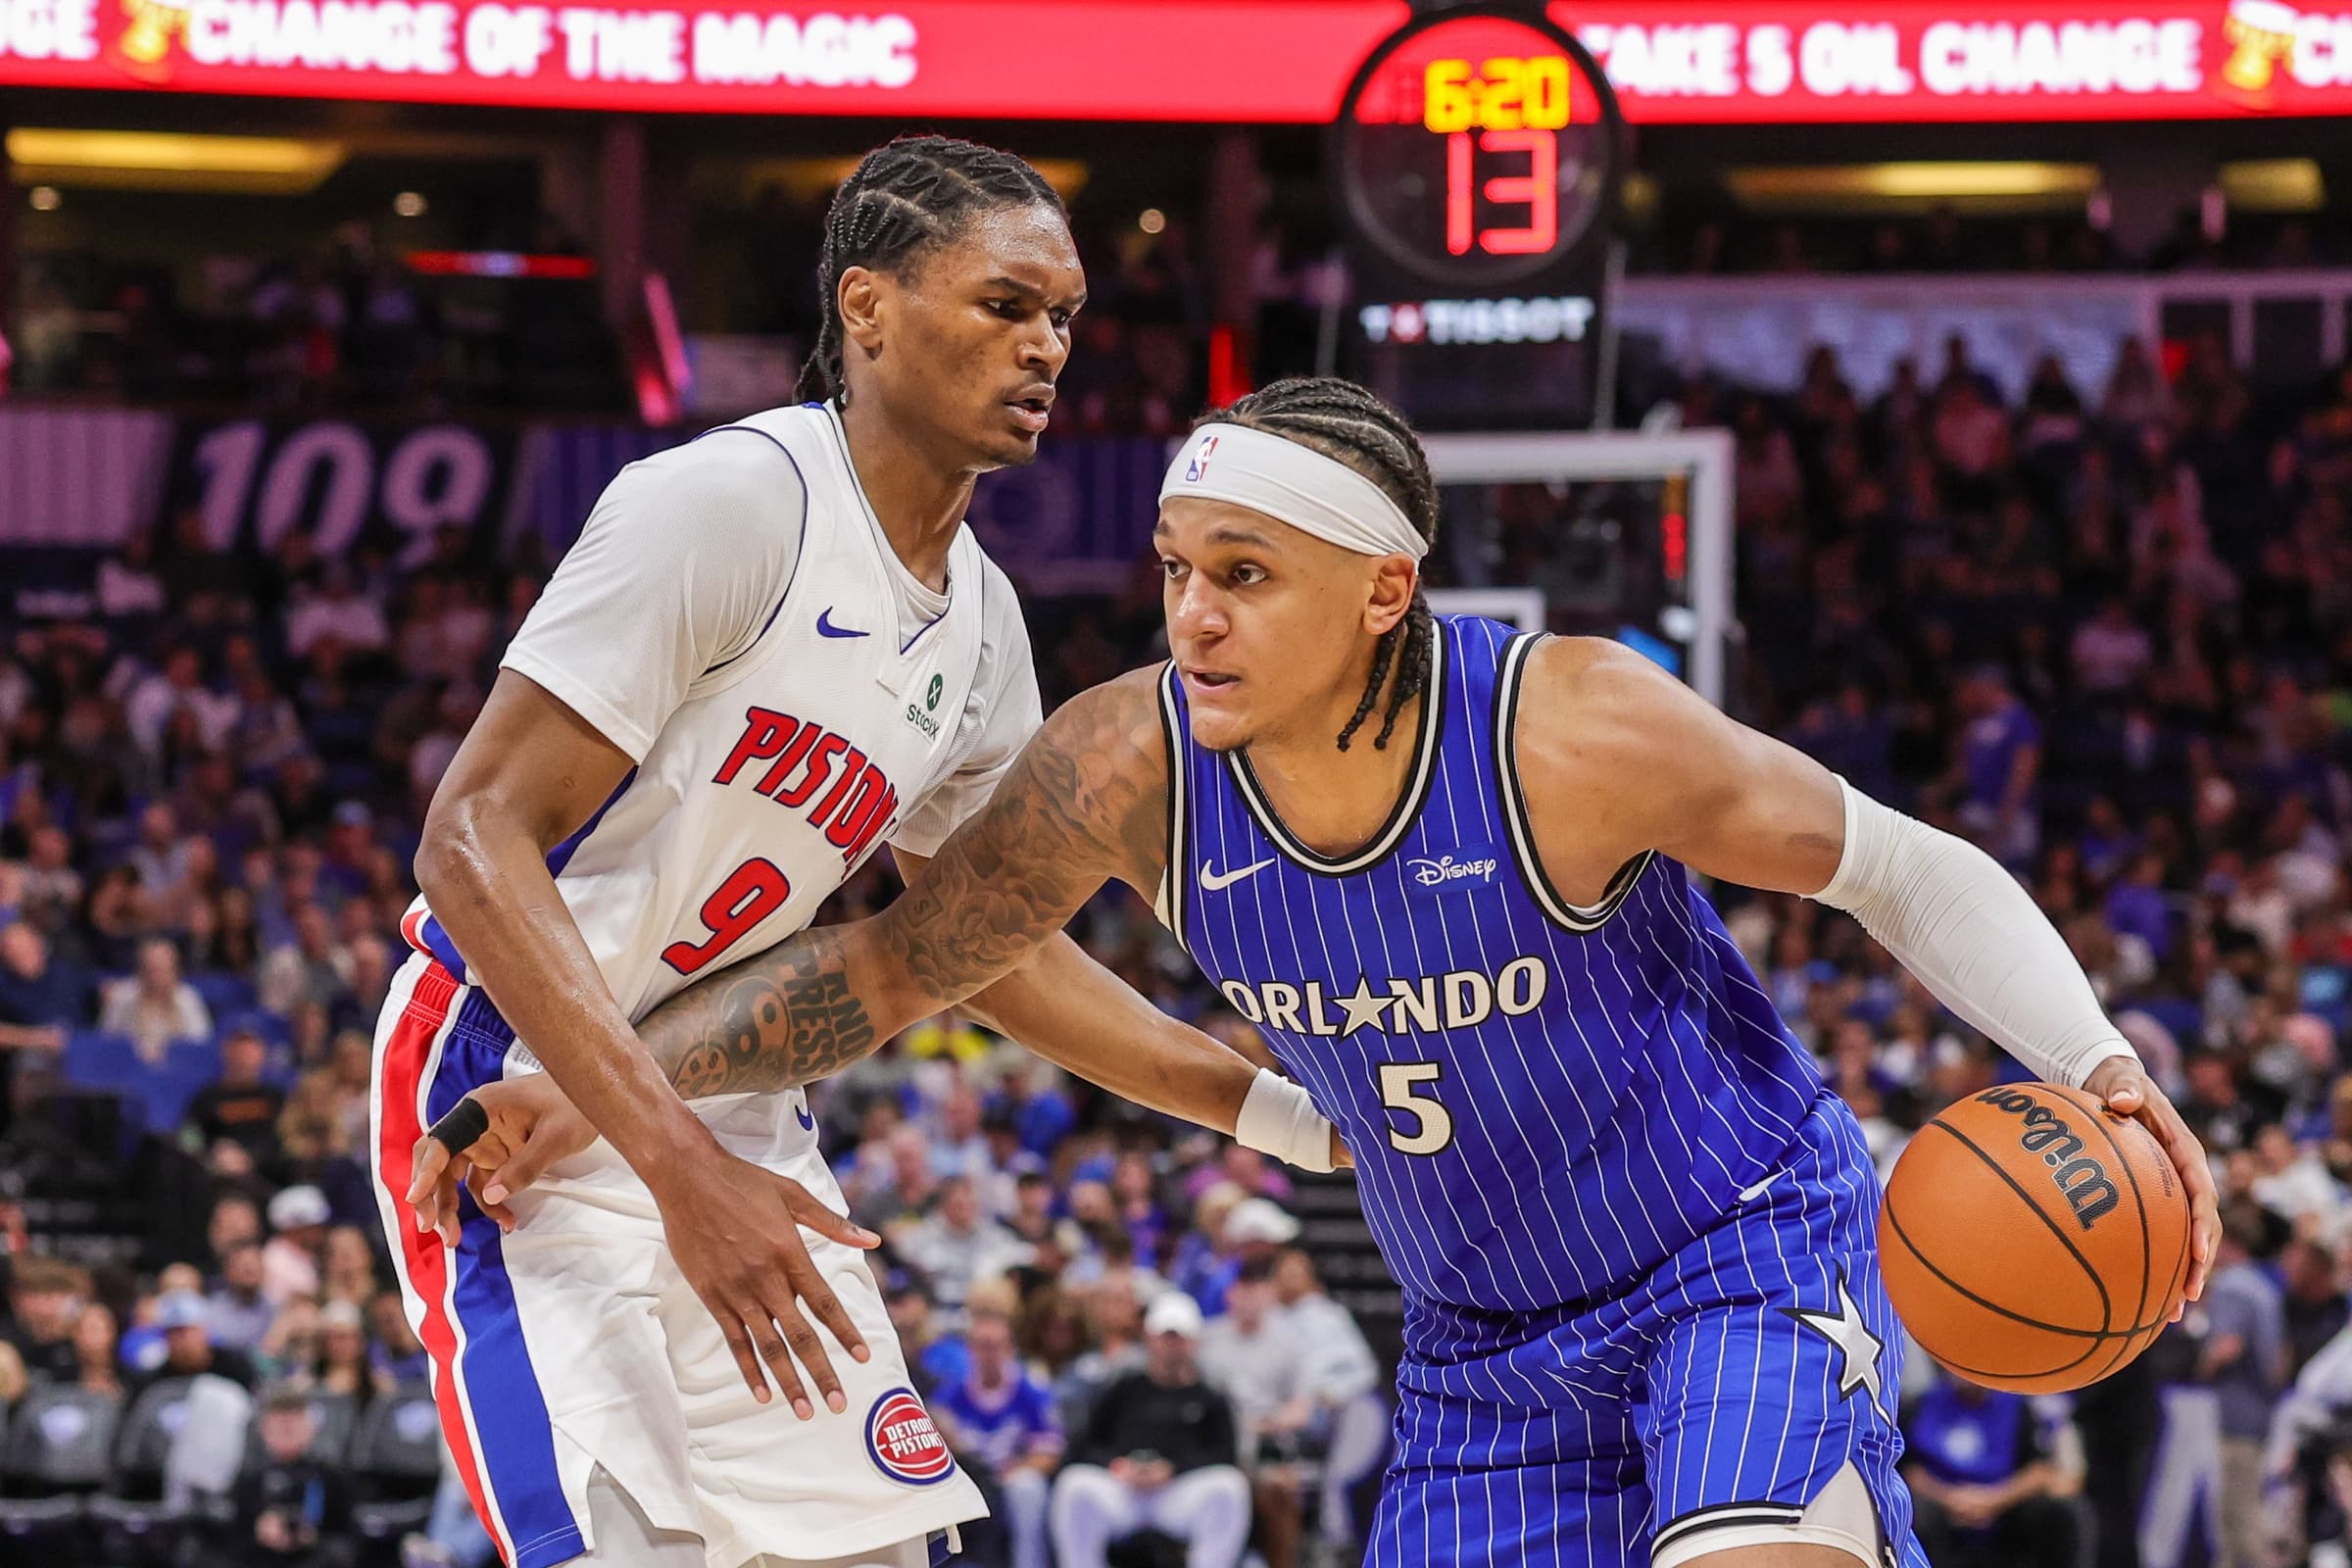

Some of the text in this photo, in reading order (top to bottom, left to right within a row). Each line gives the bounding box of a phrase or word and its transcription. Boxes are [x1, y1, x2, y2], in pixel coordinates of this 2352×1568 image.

[0, 0, 98, 61] GE
[188, 0, 917, 87] CHANGE OF THE MAGIC
[1799, 20, 1916, 96] OIL
[1918, 18, 2205, 95] CHANGE
[1424, 56, 1569, 133] 6:20
[1447, 129, 1557, 256] 13
[1424, 297, 1595, 344] TISSOT
[193, 419, 493, 570] 109
[660, 857, 791, 976] 9
[1378, 1060, 1455, 1155] 5
[1975, 1087, 2121, 1233] Wilson
